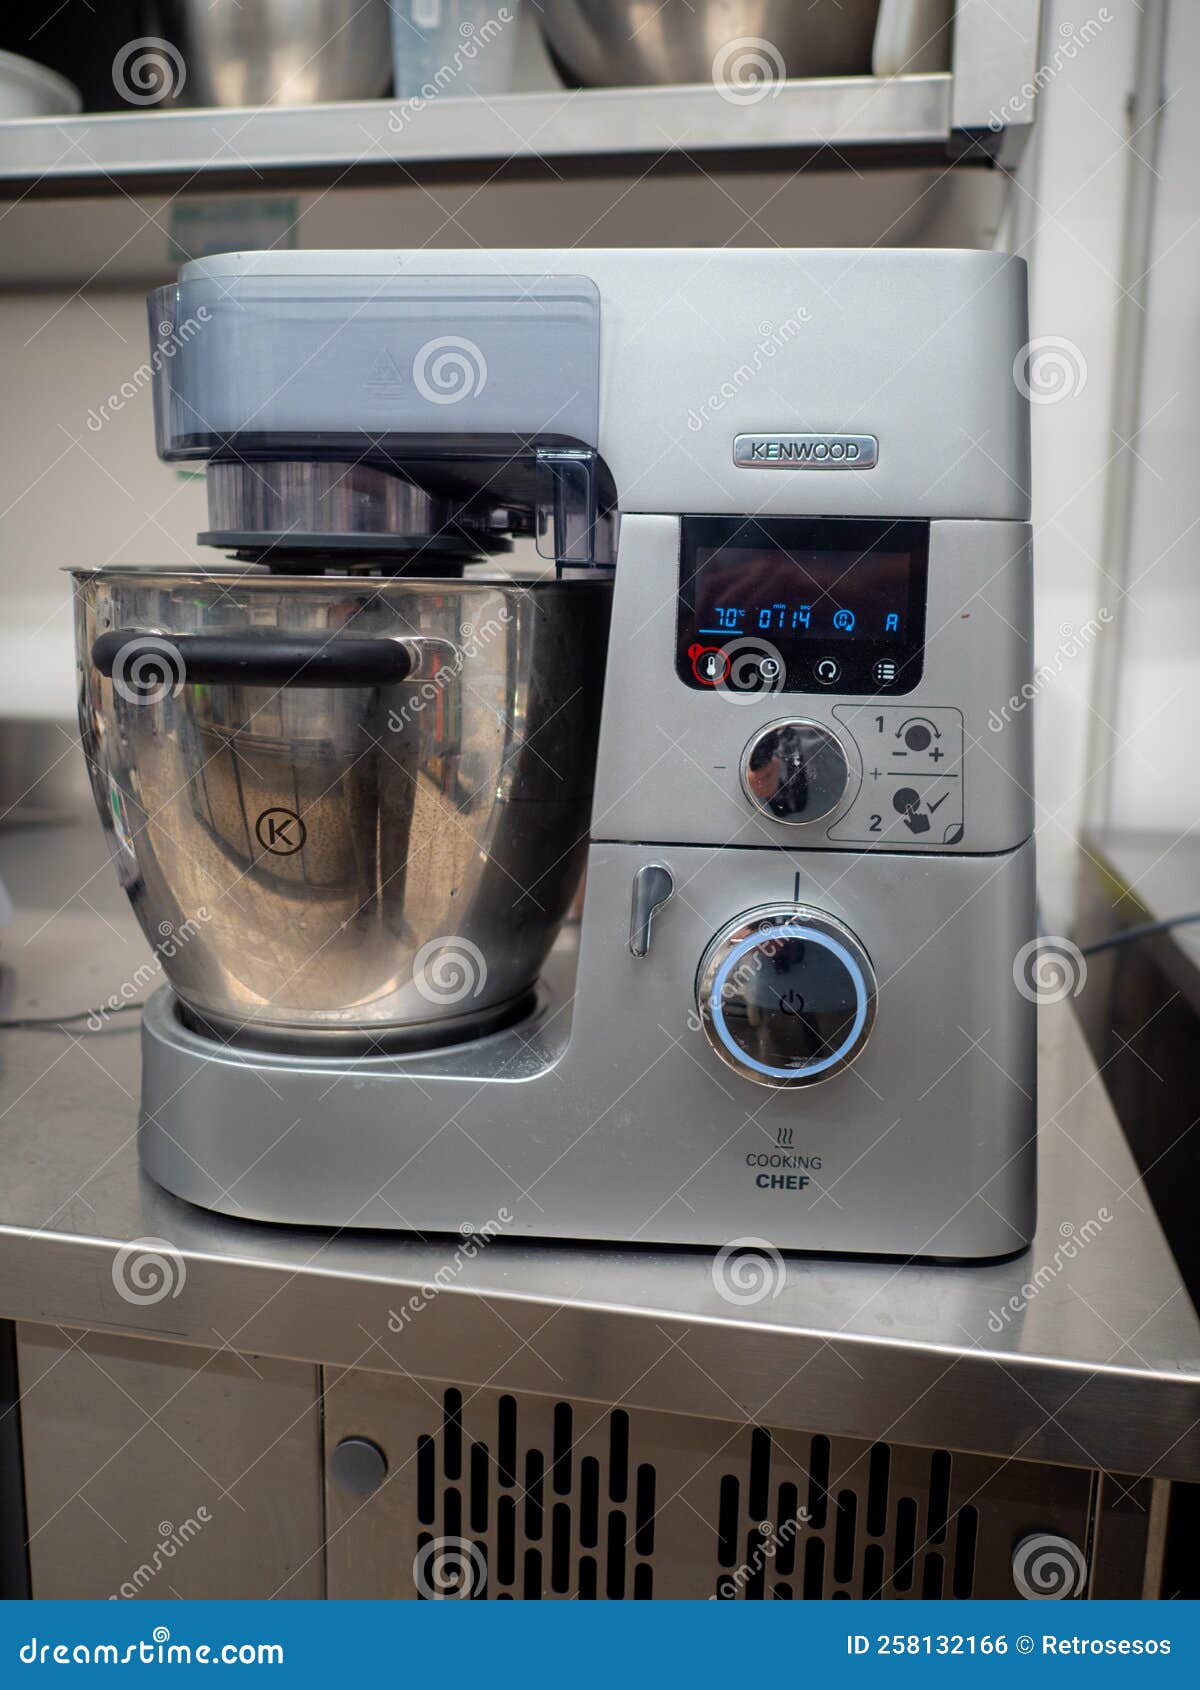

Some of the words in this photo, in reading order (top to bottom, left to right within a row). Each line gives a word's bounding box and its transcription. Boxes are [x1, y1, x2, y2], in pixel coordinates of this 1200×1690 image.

[751, 442, 860, 461] KENWOOD
[885, 613, 898, 632] A
[875, 715, 885, 733] 1
[869, 814, 882, 832] 2
[746, 1153, 822, 1170] COOKING
[755, 1173, 810, 1190] CHEF
